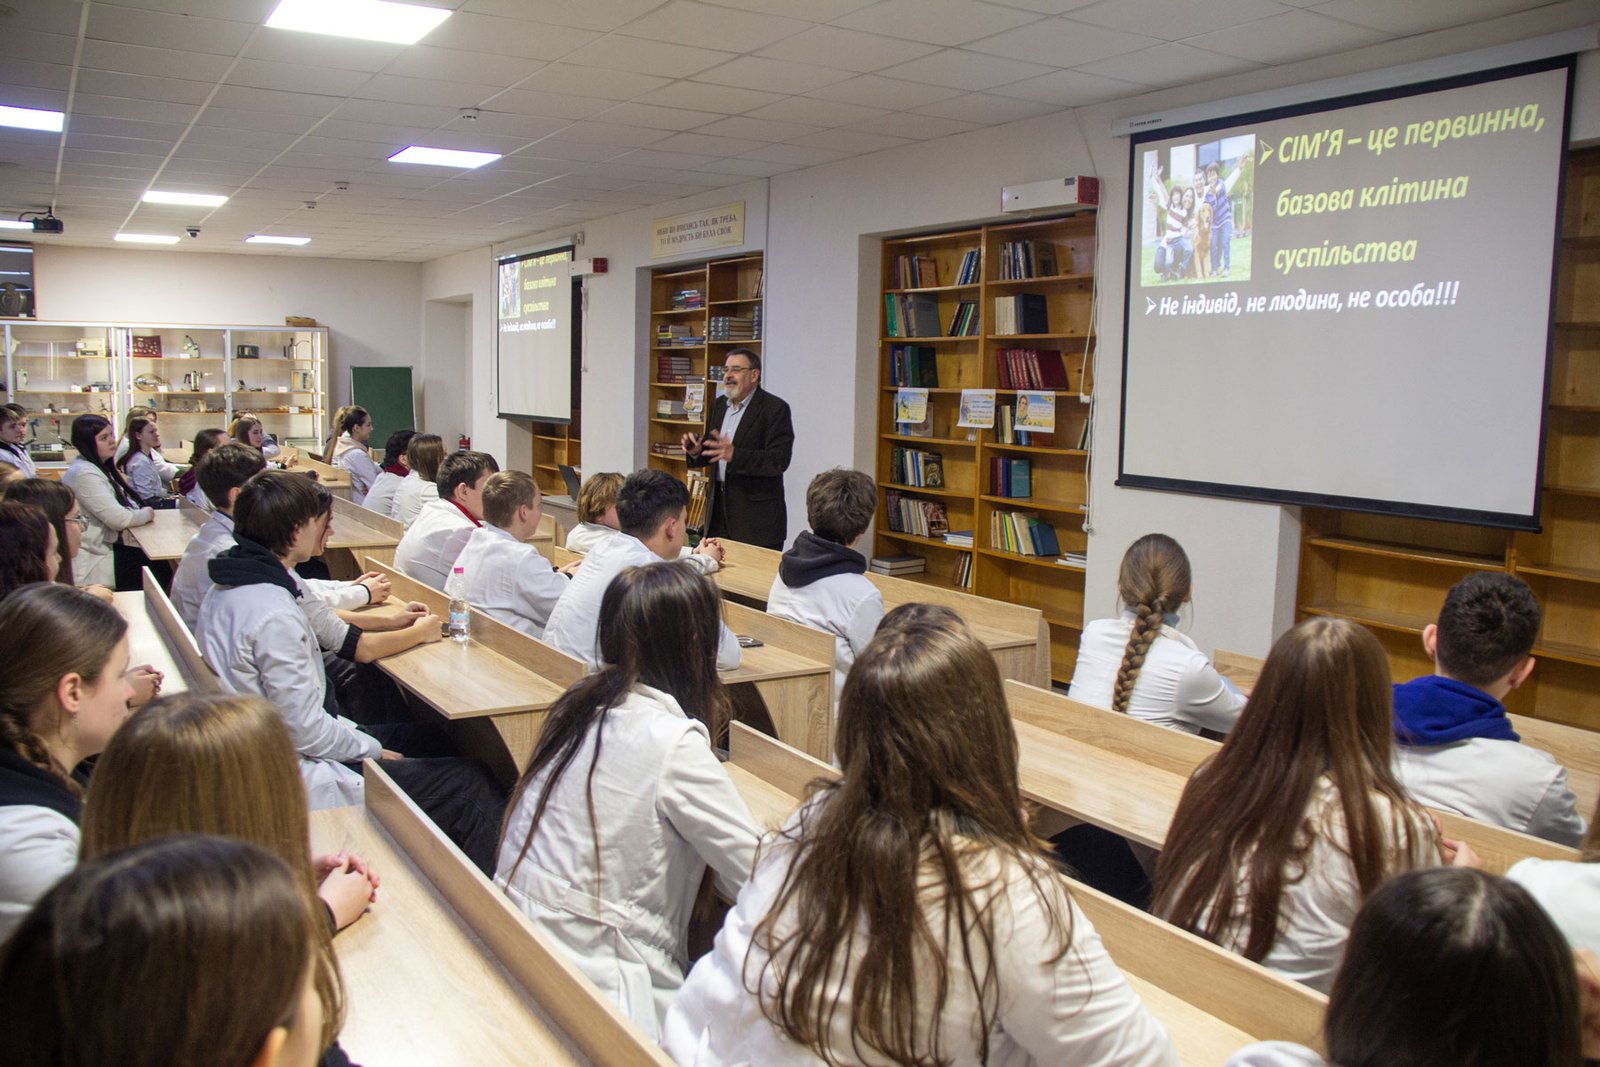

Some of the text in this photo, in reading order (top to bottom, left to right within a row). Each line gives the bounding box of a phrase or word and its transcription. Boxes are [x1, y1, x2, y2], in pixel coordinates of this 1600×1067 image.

[1367, 126, 1399, 156] це
[1403, 103, 1546, 149] первинна,
[1276, 176, 1470, 217] базова клітина
[1273, 239, 1418, 275] суспільства
[1159, 280, 1460, 317] Не індивід, не людина, не особа!!!
